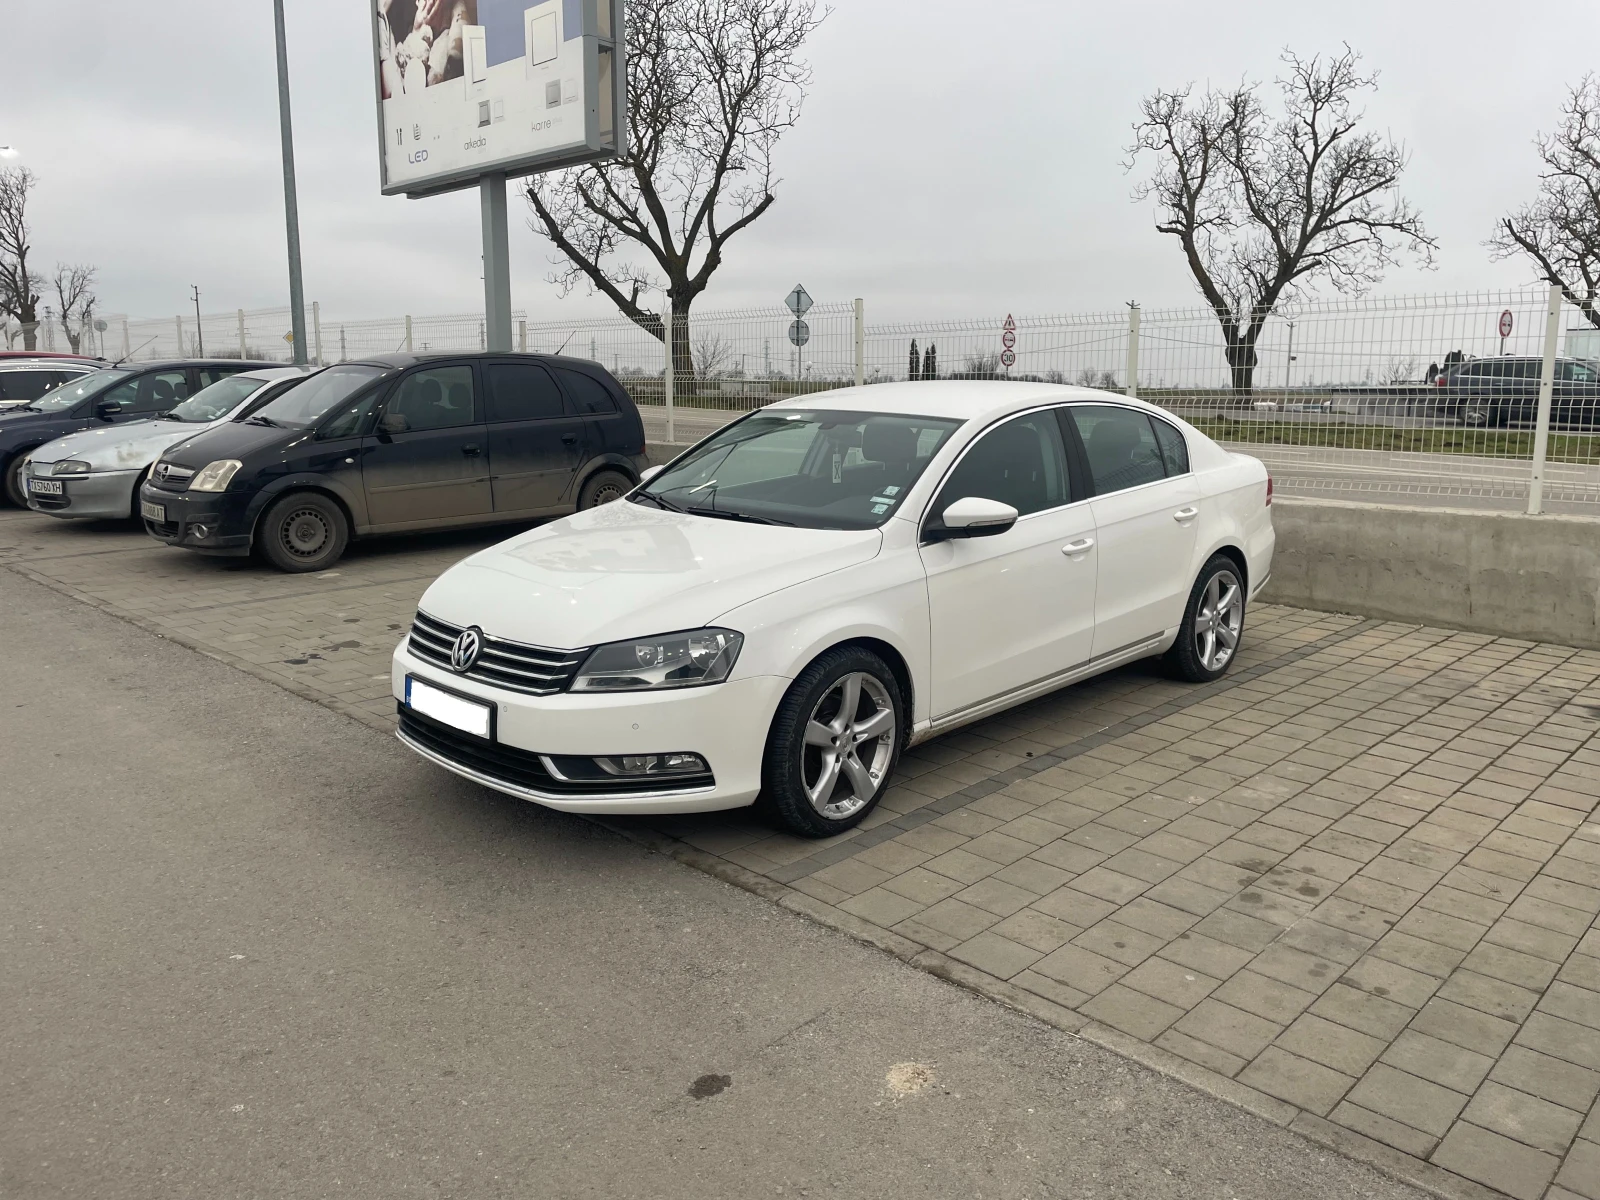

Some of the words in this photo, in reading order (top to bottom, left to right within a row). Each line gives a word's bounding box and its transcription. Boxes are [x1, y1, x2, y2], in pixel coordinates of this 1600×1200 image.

[531, 121, 552, 133] karre
[463, 136, 487, 151] arkedia
[408, 150, 429, 164] LED
